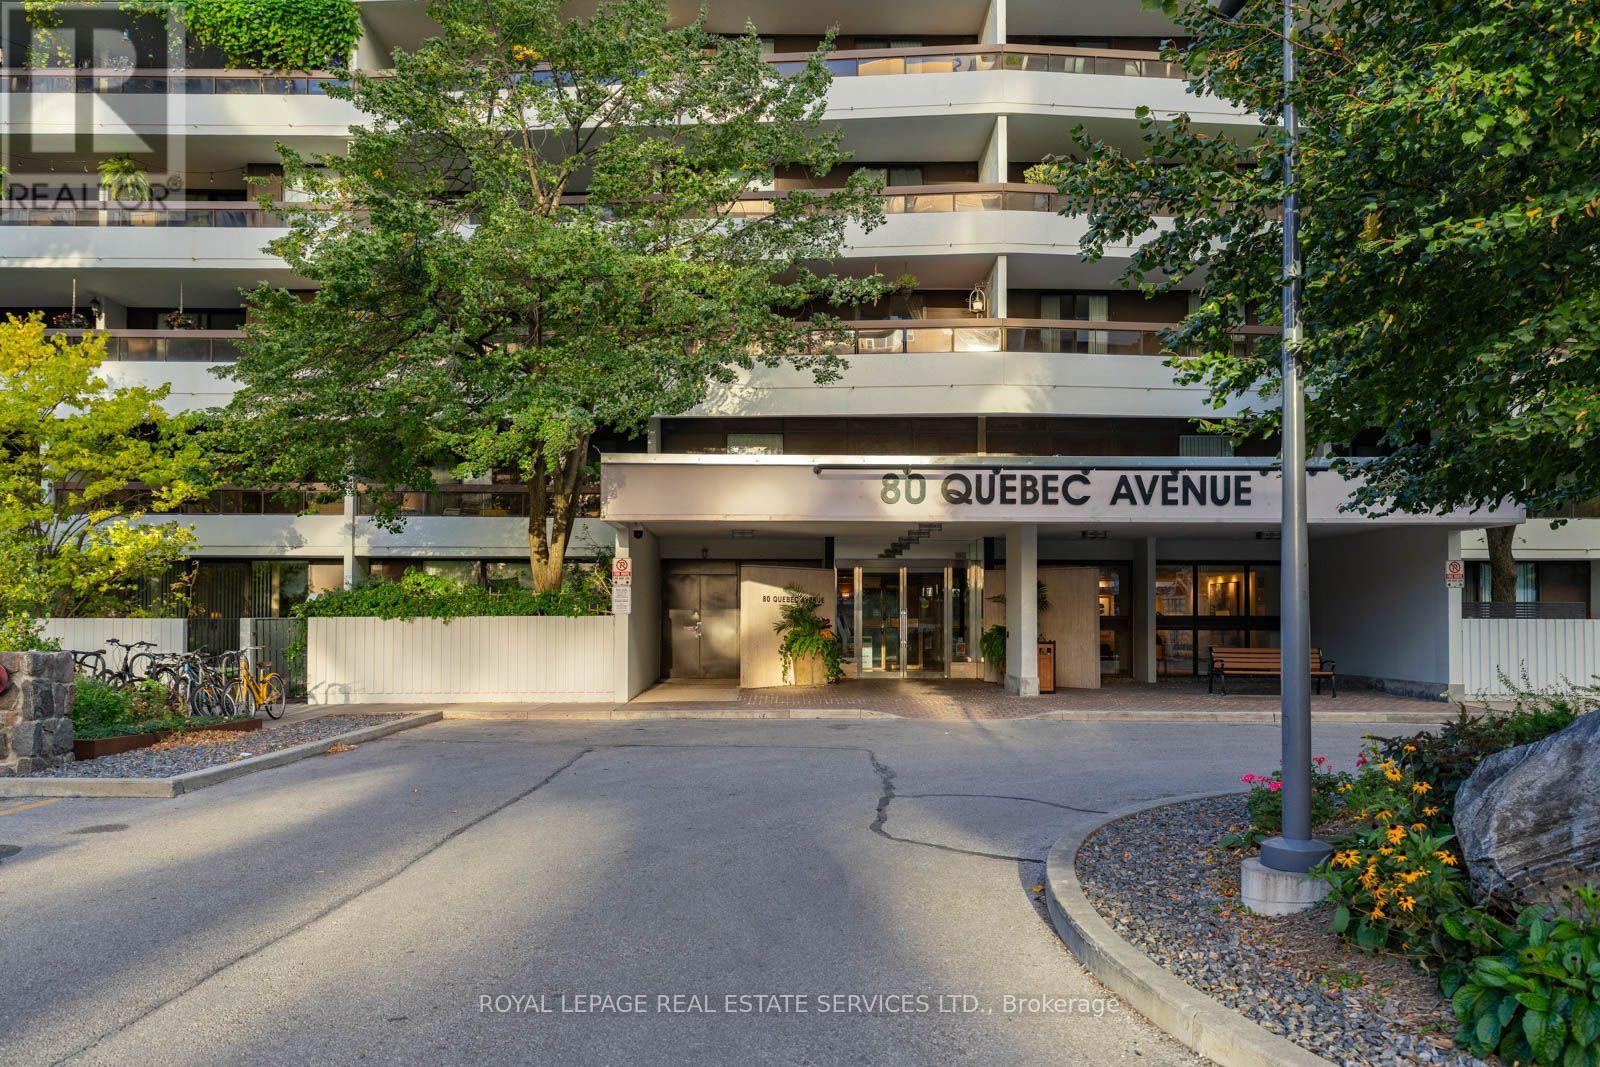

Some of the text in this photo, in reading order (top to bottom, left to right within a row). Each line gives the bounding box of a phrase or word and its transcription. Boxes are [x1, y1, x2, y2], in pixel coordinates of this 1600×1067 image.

[880, 473, 1252, 506] 80 QUEBEC AVENUE
[772, 595, 798, 603] QUEBEC
